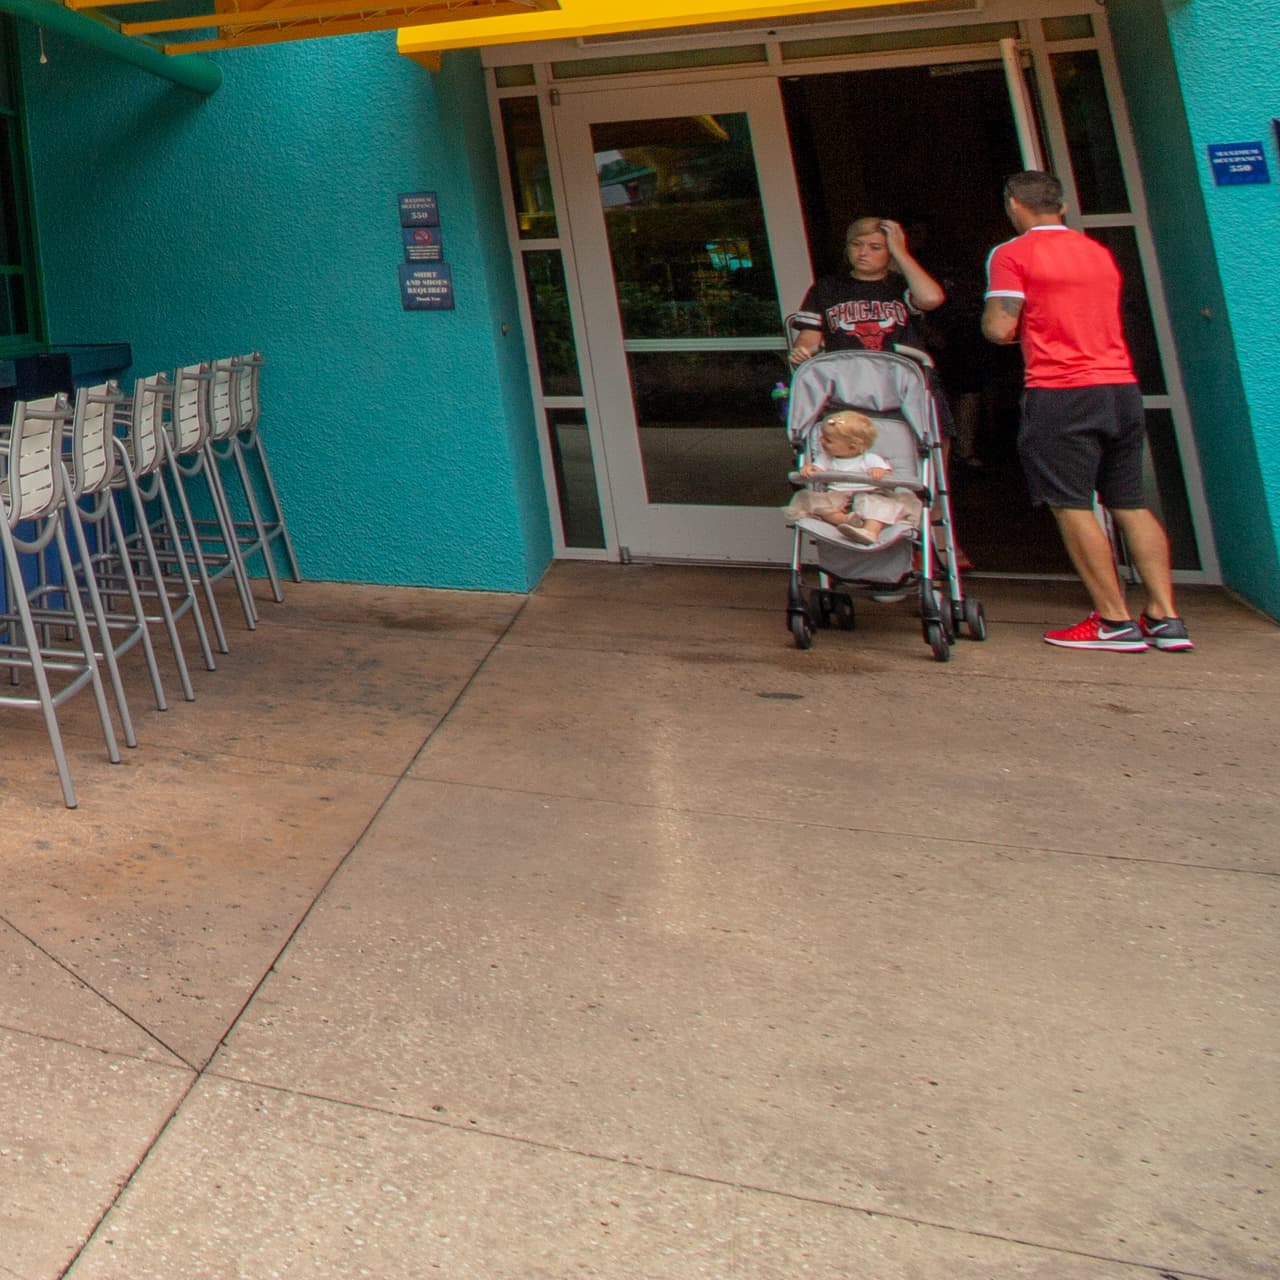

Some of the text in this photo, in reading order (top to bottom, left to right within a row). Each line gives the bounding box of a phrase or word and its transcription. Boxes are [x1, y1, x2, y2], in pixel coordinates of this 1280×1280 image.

[1215, 149, 1261, 157] MAXIMUM
[1213, 155, 1264, 164] OCCUPANCY
[413, 271, 437, 279] SHIRT
[407, 286, 448, 295] REQUIRED
[825, 300, 909, 333] CHICAGO
